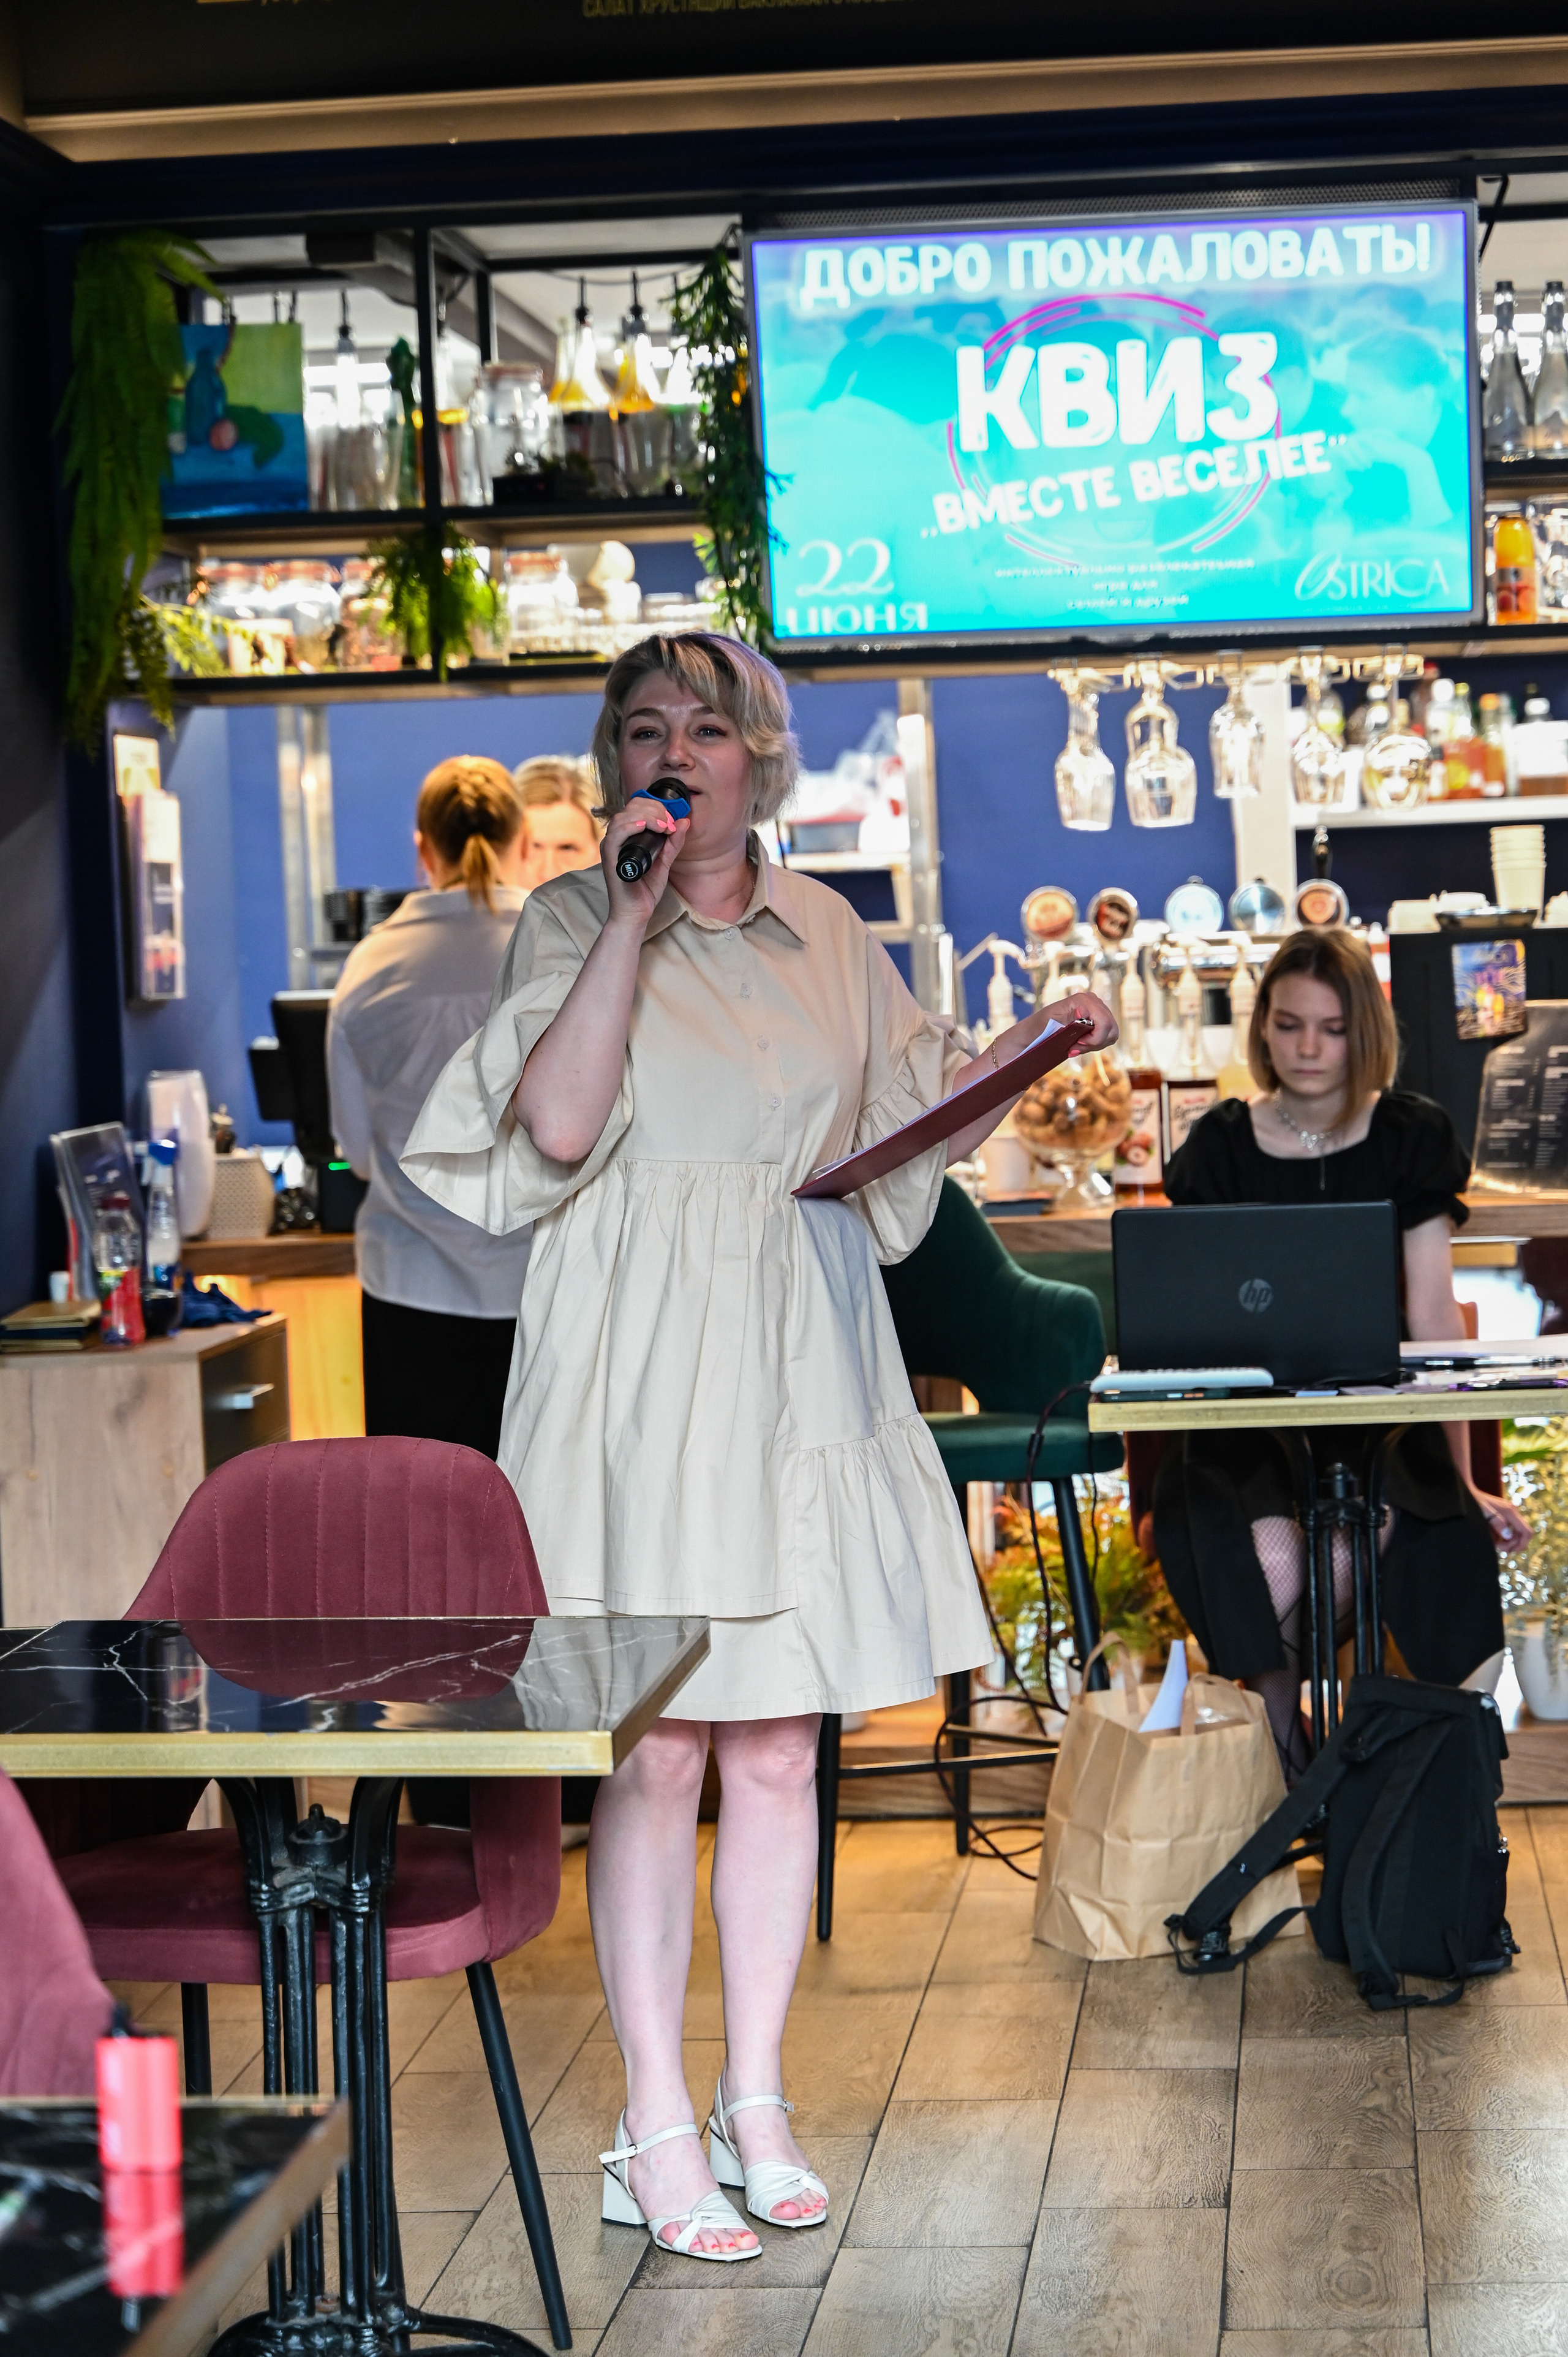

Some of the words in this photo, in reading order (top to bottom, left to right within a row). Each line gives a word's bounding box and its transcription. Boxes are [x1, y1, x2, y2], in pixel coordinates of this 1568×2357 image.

[799, 242, 992, 309] ДОБРО
[1008, 222, 1431, 290] ПОЖАЛОВАТЬ!
[956, 331, 1280, 453] КВИЗ
[796, 537, 895, 598] 22
[625, 864, 634, 877] MIC
[1239, 1279, 1273, 1312] hp
